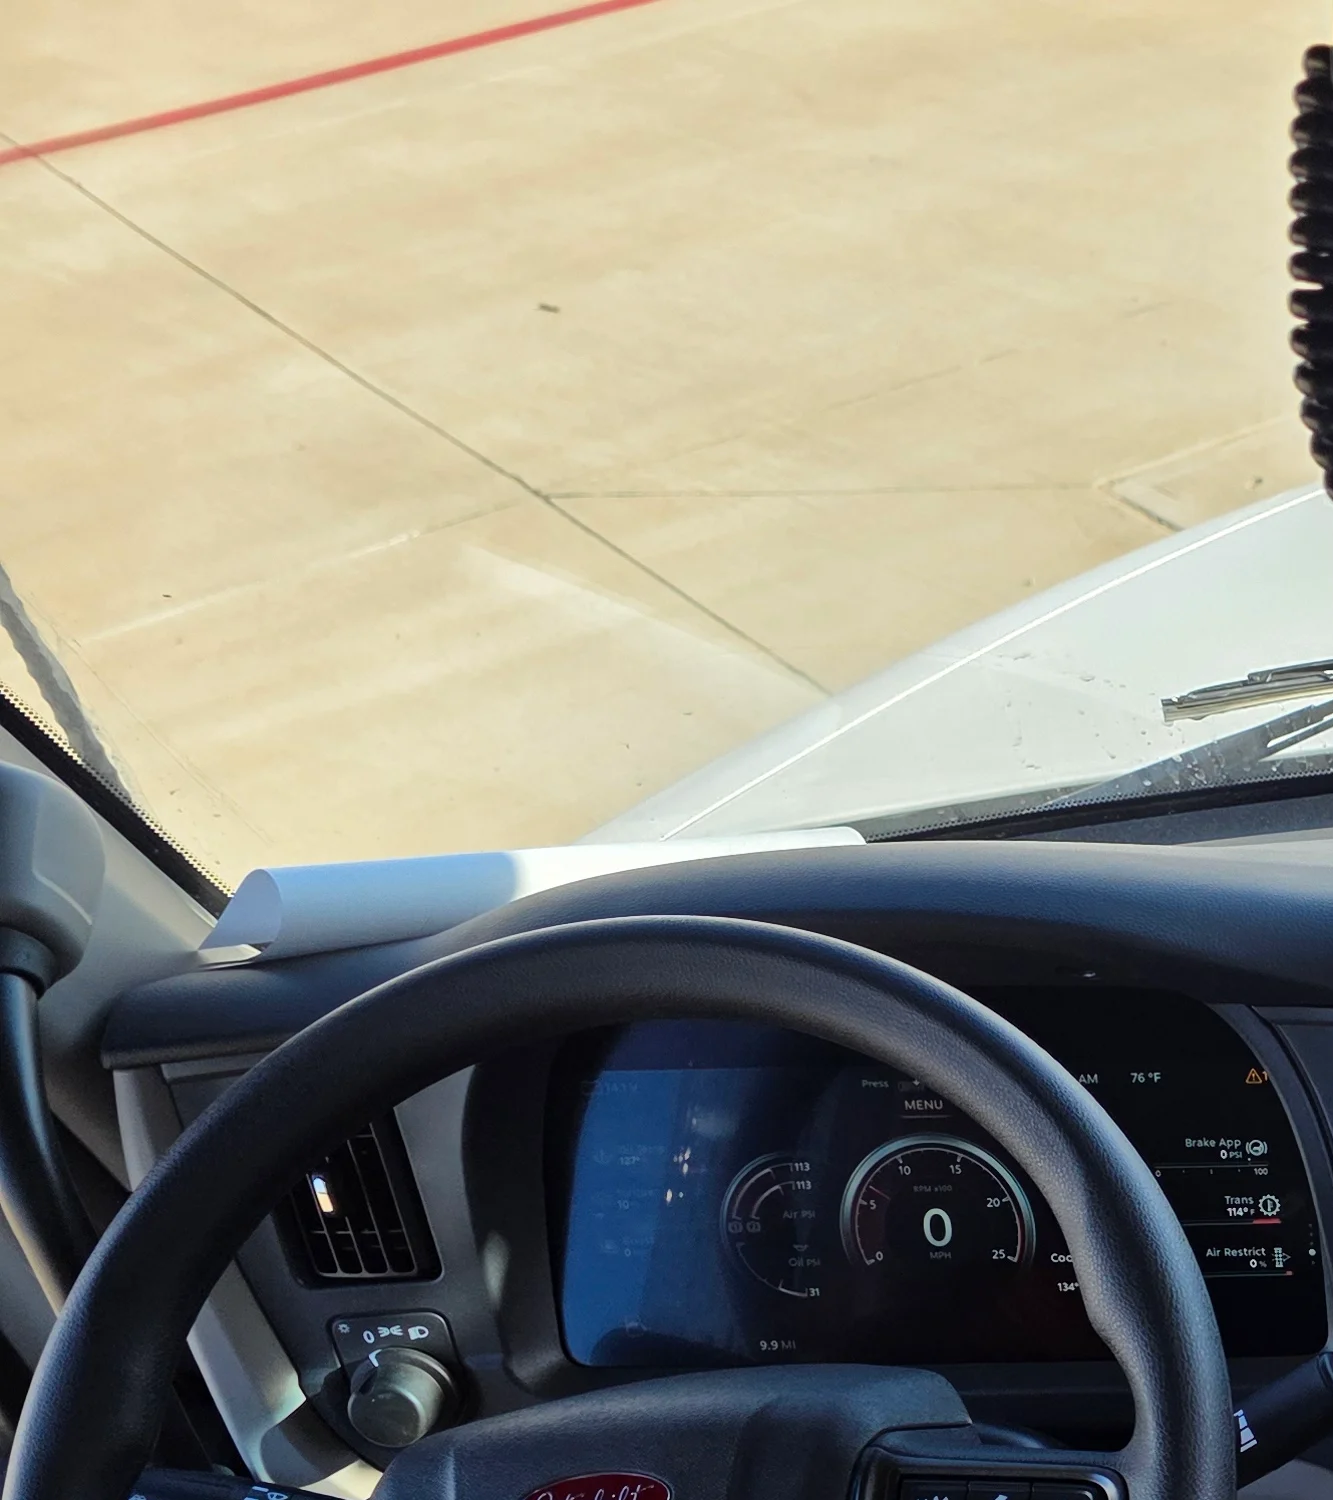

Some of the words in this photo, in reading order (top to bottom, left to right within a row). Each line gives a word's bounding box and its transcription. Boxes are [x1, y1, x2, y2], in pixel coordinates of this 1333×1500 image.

[1078, 1074, 1099, 1084] AM
[1130, 1072, 1146, 1083] 76
[861, 1079, 889, 1088] Press
[904, 1100, 944, 1111] MENU
[1184, 1138, 1216, 1148] Brake
[1218, 1138, 1242, 1150] App
[1220, 1150, 1228, 1160] 0
[1229, 1151, 1243, 1159] PSI
[794, 1162, 811, 1172] 113
[898, 1165, 912, 1176] 10
[949, 1164, 962, 1175] 15
[1254, 1167, 1269, 1176] 100
[796, 1181, 812, 1191] 113
[869, 1200, 877, 1210] 5
[986, 1197, 1001, 1208] 20
[1224, 1195, 1254, 1205] Trans
[783, 1210, 799, 1220] Air
[922, 1207, 953, 1247] 0
[875, 1251, 884, 1261] 0
[929, 1251, 952, 1260] MPH
[991, 1249, 1006, 1260] 25
[1206, 1248, 1221, 1258] Air
[1224, 1247, 1267, 1257] Restrict
[788, 1257, 804, 1268] Oil
[806, 1258, 821, 1267] PSI
[809, 1287, 821, 1298] 31
[759, 1339, 780, 1352] 9.9
[781, 1340, 797, 1351] MI
